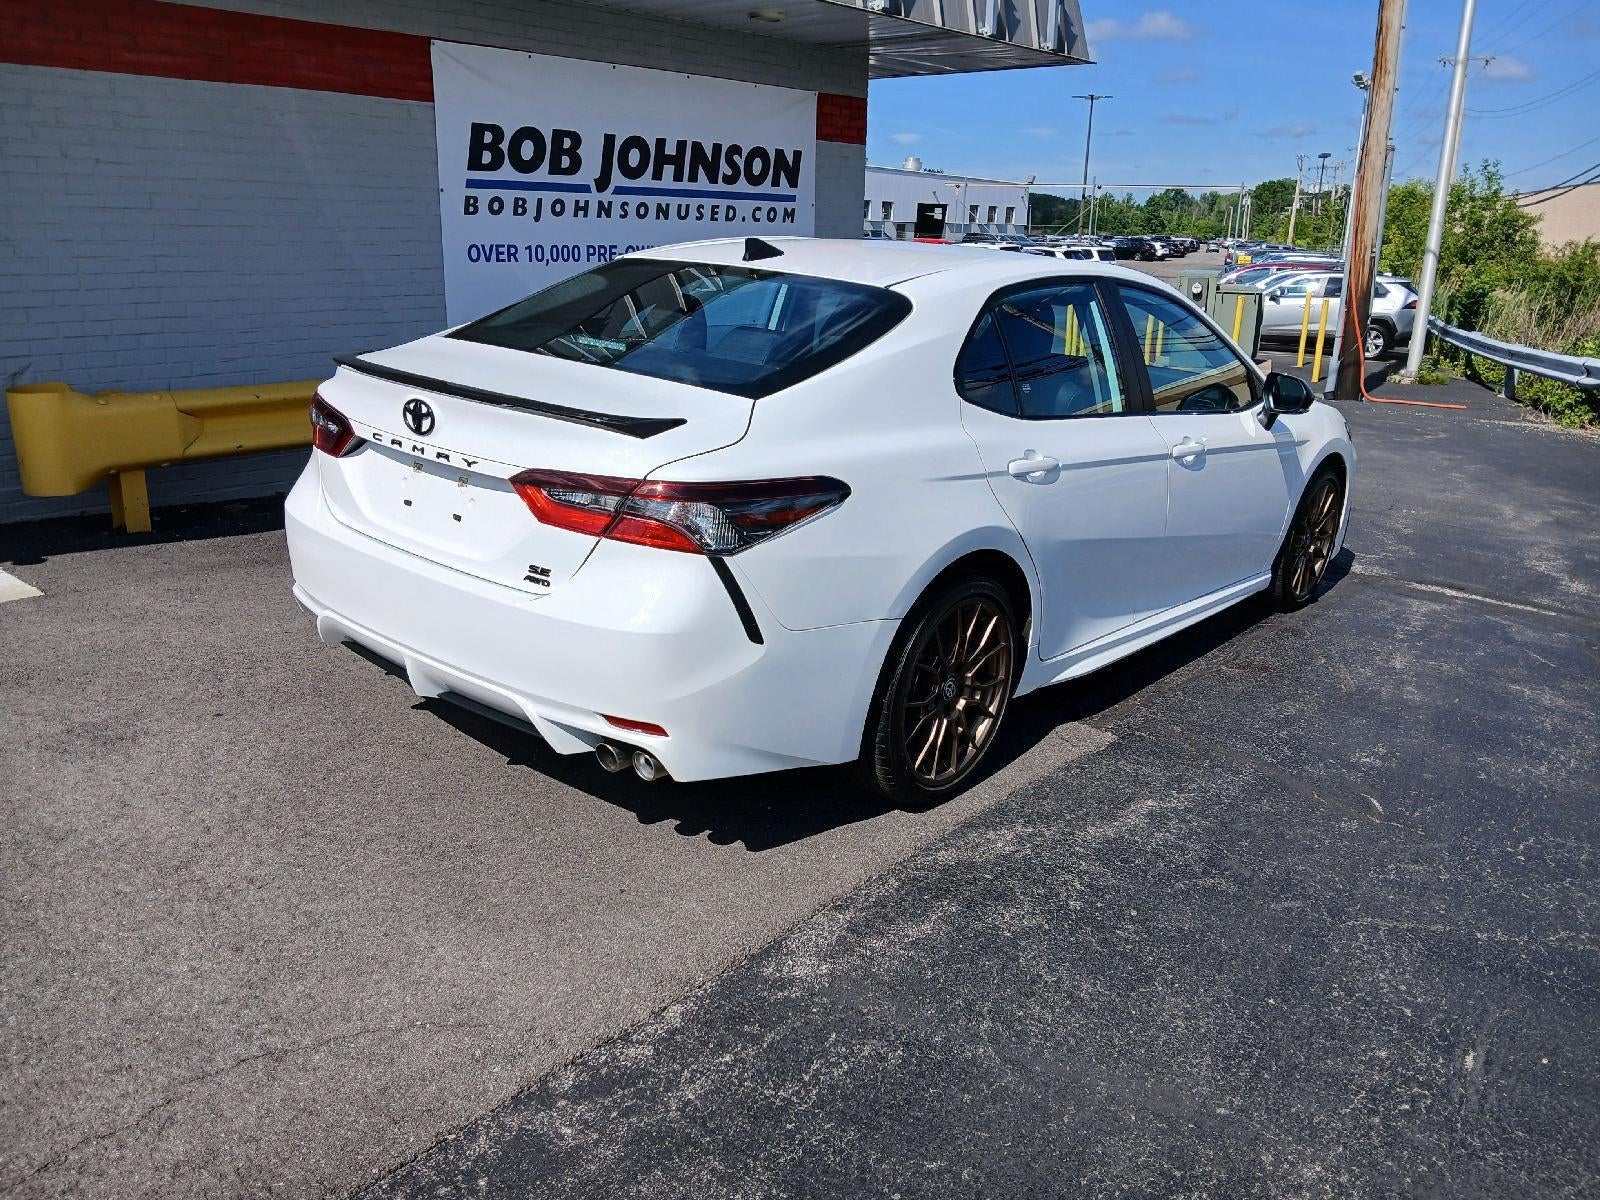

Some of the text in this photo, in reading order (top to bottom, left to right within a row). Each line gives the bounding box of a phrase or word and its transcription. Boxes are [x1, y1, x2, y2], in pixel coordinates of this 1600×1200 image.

[467, 122, 802, 193] BOB JOHNSON
[463, 195, 796, 223] BOBJOHNSONUSED.COM
[467, 244, 519, 262] OVER
[525, 245, 581, 267] 10,000
[372, 432, 479, 468] CAMRY
[523, 575, 551, 587] AWD
[528, 564, 552, 578] SE
